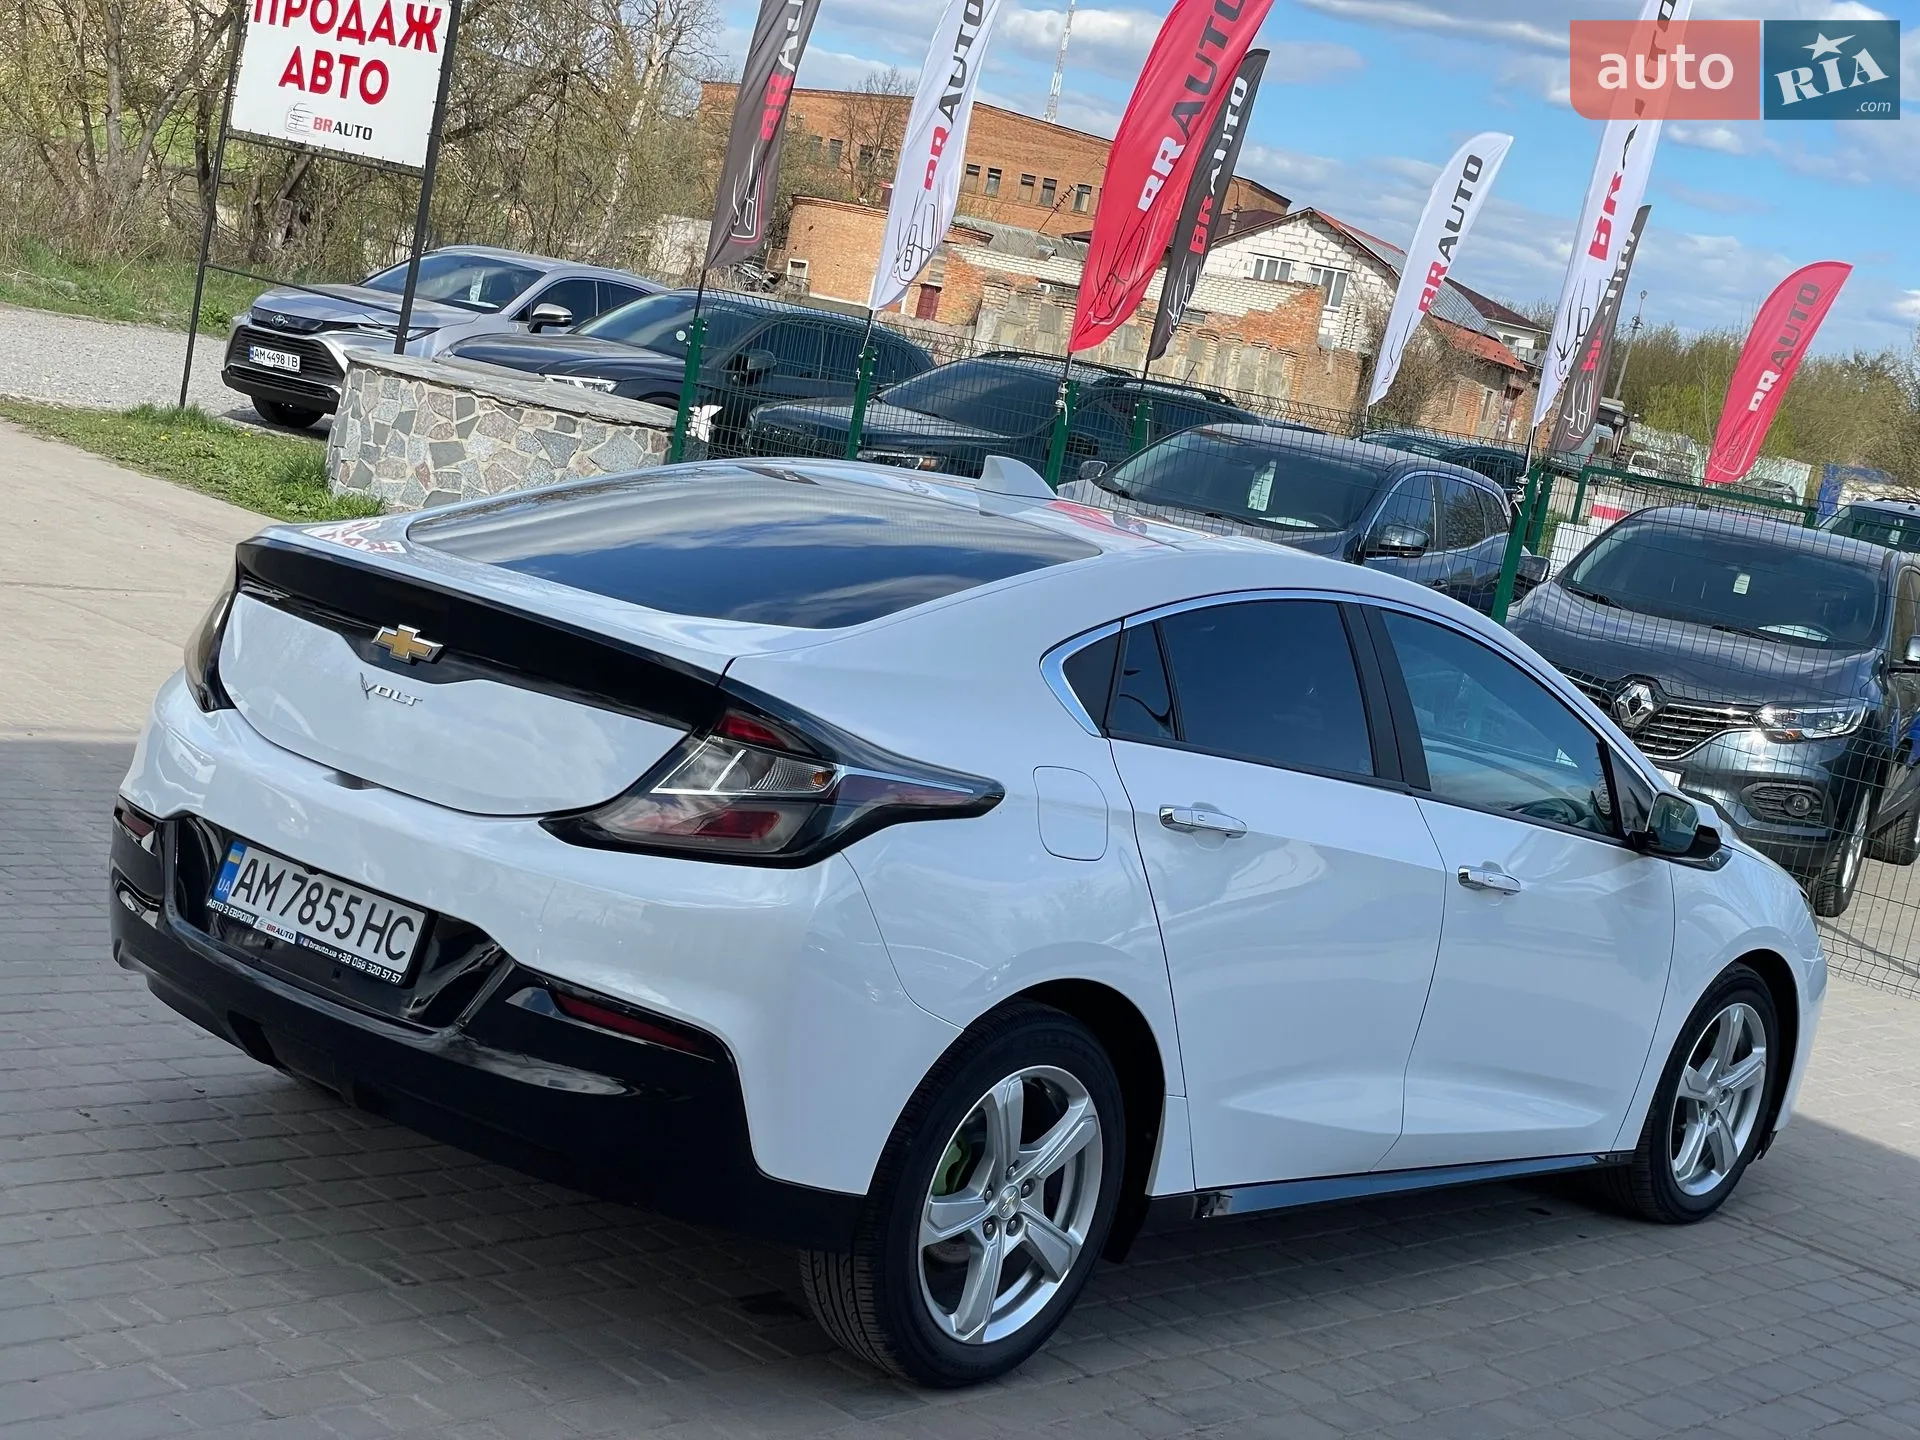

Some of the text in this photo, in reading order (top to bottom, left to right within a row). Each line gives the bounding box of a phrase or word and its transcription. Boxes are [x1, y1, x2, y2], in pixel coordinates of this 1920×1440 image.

[278, 45, 390, 105] АВТО
[312, 116, 373, 141] BRAUTO
[1417, 154, 1484, 313] BRAUTO
[1747, 283, 1821, 412] BRAUTO
[360, 671, 423, 707] VOLT
[217, 877, 231, 894] UA
[265, 923, 294, 940] BRAUTO
[366, 965, 381, 977] 320
[380, 968, 392, 980] 57
[390, 972, 403, 984] 57
